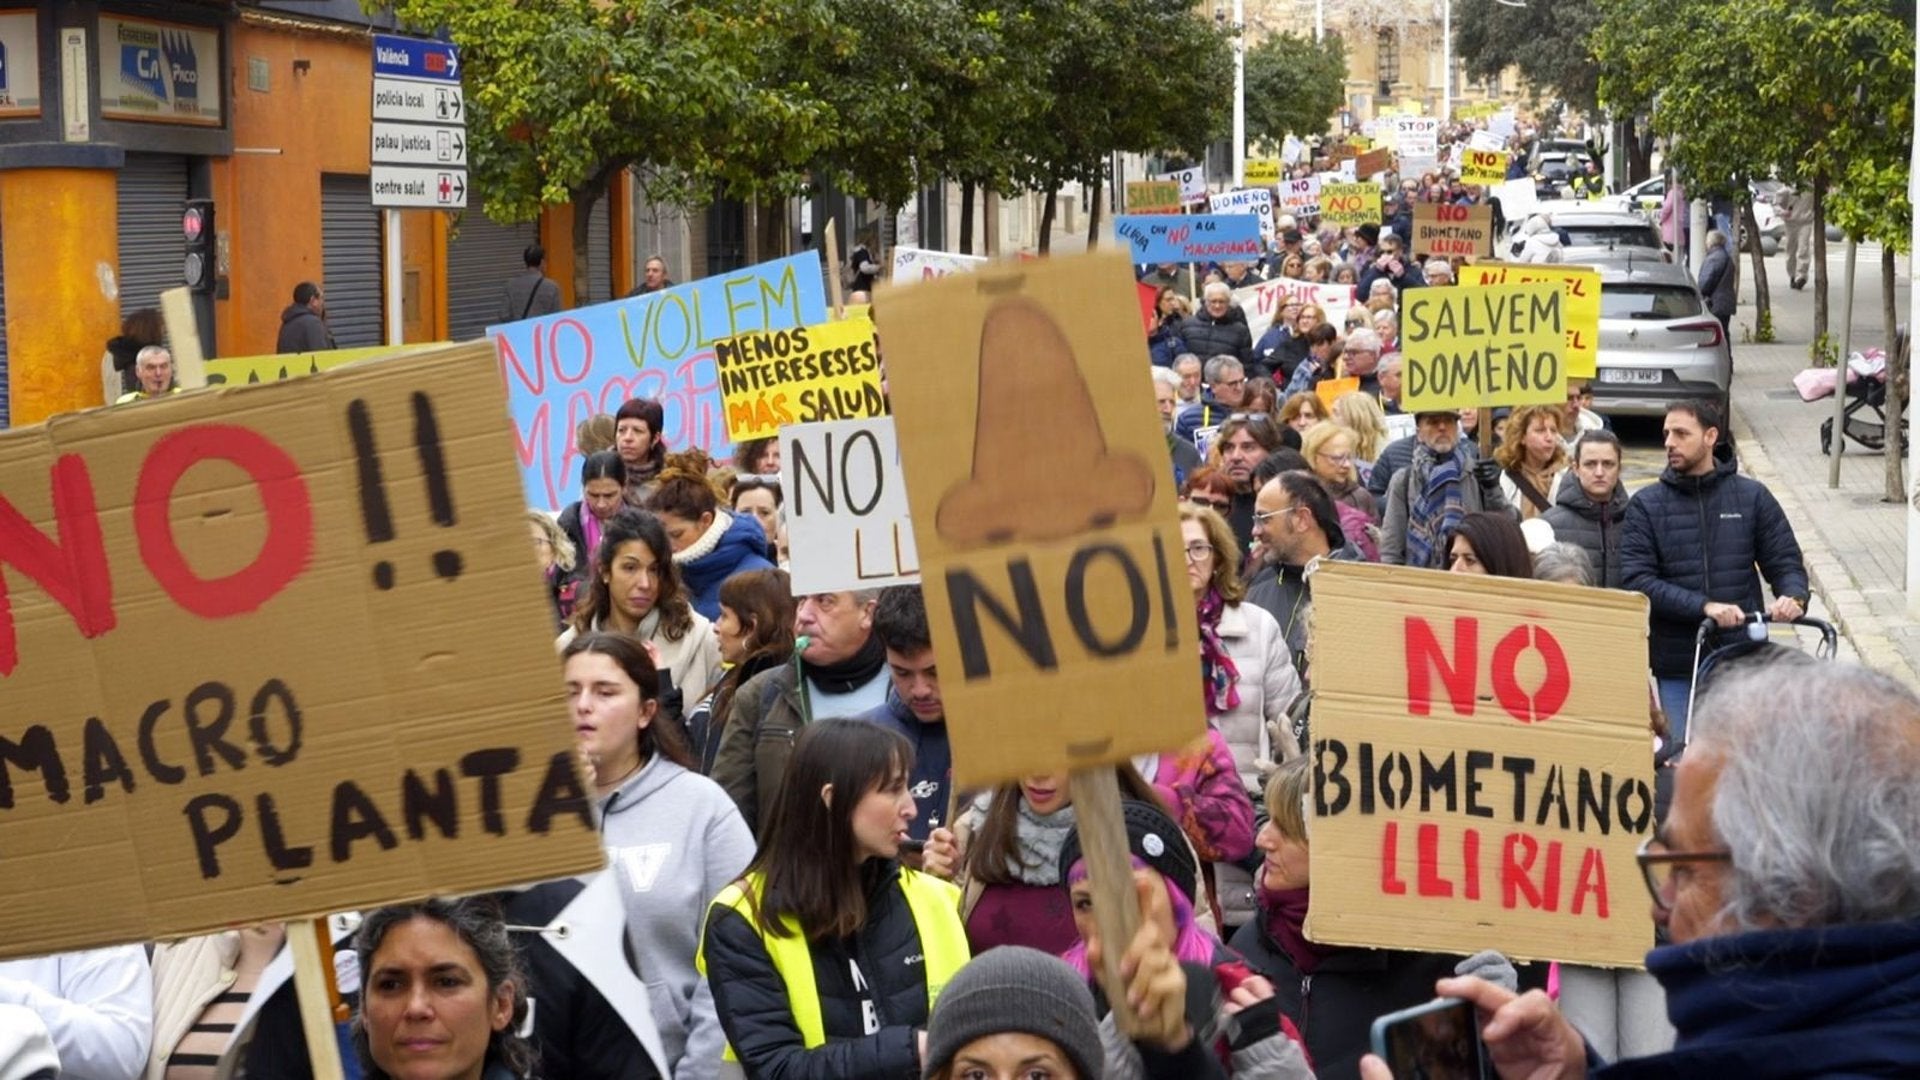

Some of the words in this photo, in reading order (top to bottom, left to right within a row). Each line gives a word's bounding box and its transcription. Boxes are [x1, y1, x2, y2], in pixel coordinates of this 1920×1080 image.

[376, 47, 409, 66] València
[405, 91, 425, 108] local
[375, 133, 399, 151] palau
[1398, 121, 1434, 131] STOP
[1473, 152, 1497, 166] NO
[375, 180, 401, 195] centre
[404, 180, 425, 196] salut
[1212, 191, 1270, 211] DOMEÑO
[1291, 181, 1309, 193] NO
[1328, 196, 1363, 213] NO
[1167, 224, 1191, 245] NO
[1420, 225, 1482, 240] BIOMETANO
[1437, 205, 1468, 223] NO
[497, 318, 593, 396] NO
[619, 264, 804, 368] VOLEM
[1408, 290, 1561, 342] SALVEM
[716, 327, 810, 368] MENOS
[720, 344, 877, 396] INTERESESES
[1408, 342, 1558, 398] DOMEÑO
[729, 393, 793, 434] MÁS
[800, 381, 884, 423] SALUD
[791, 428, 884, 517] NO
[945, 527, 1180, 681] NO!
[1404, 616, 1572, 724] NO
[0, 678, 304, 808] MACRO
[1314, 738, 1653, 836] BIOMETANO
[183, 746, 595, 878] PLANTA
[1381, 821, 1610, 920] LLIRIA
